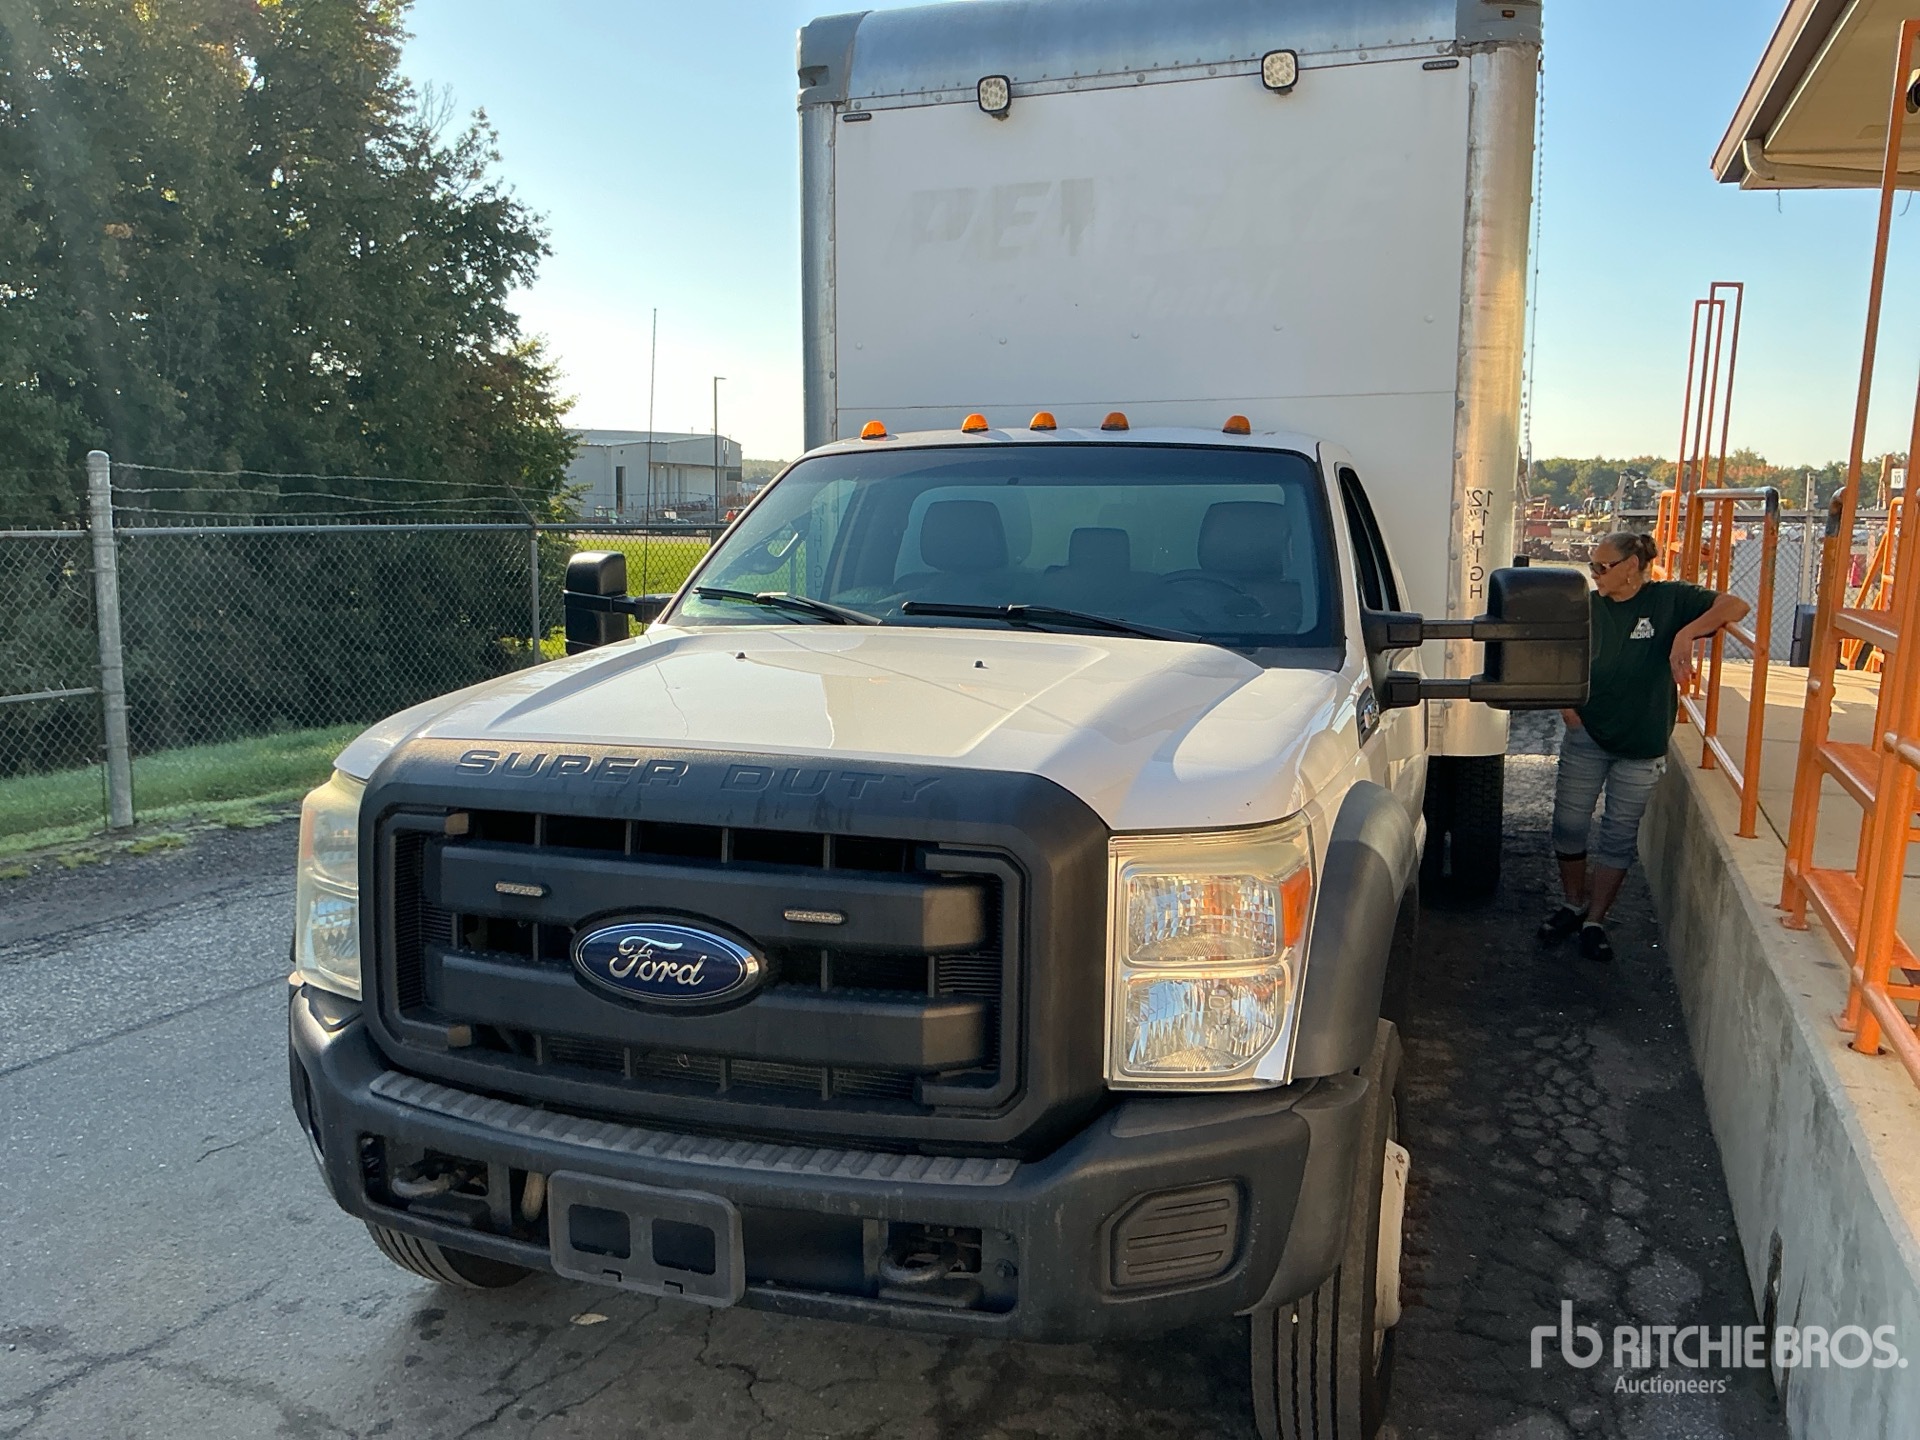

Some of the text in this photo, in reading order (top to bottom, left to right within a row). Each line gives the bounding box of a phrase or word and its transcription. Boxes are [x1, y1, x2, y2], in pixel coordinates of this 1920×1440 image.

[454, 749, 943, 803] SUPER DUTY
[608, 935, 706, 987] Ford
